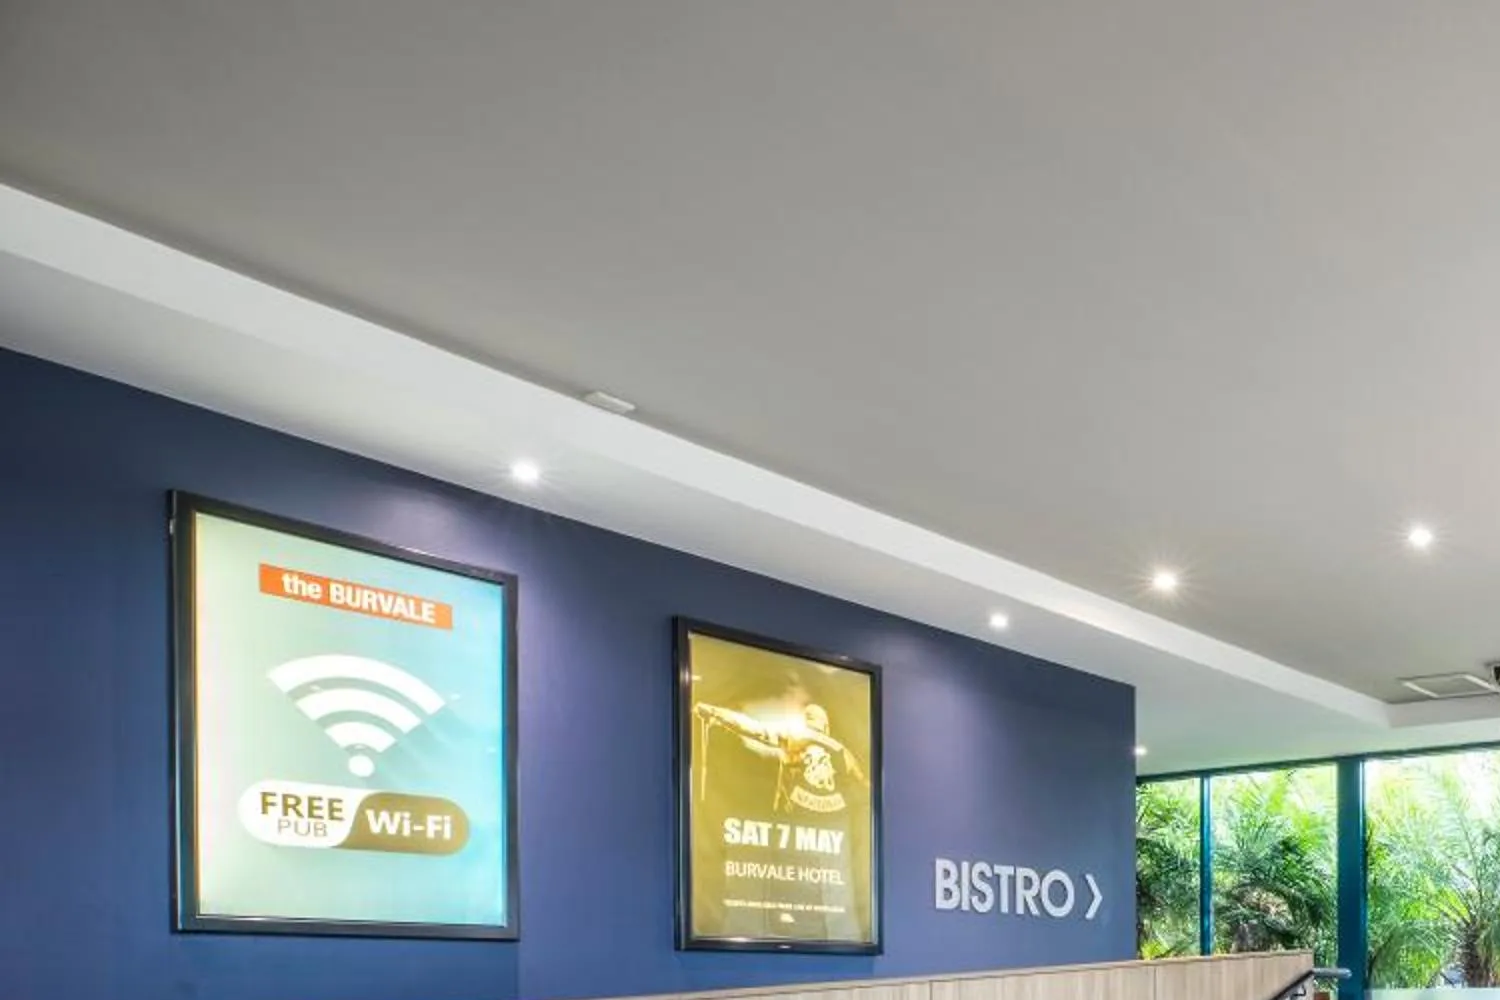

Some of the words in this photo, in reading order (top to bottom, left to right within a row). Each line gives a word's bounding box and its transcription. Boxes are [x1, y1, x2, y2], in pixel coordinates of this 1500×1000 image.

[281, 573, 322, 599] the
[330, 583, 436, 624] BURVALE
[259, 791, 344, 822] FREE
[276, 819, 328, 838] PUB
[366, 808, 453, 840] Wi-Fi
[723, 817, 772, 847] SAT
[776, 823, 791, 849] 7
[795, 826, 844, 855] MAY
[725, 860, 796, 881] BURVALE
[799, 868, 846, 885] HOTEL
[935, 858, 1075, 918] BISTRO
